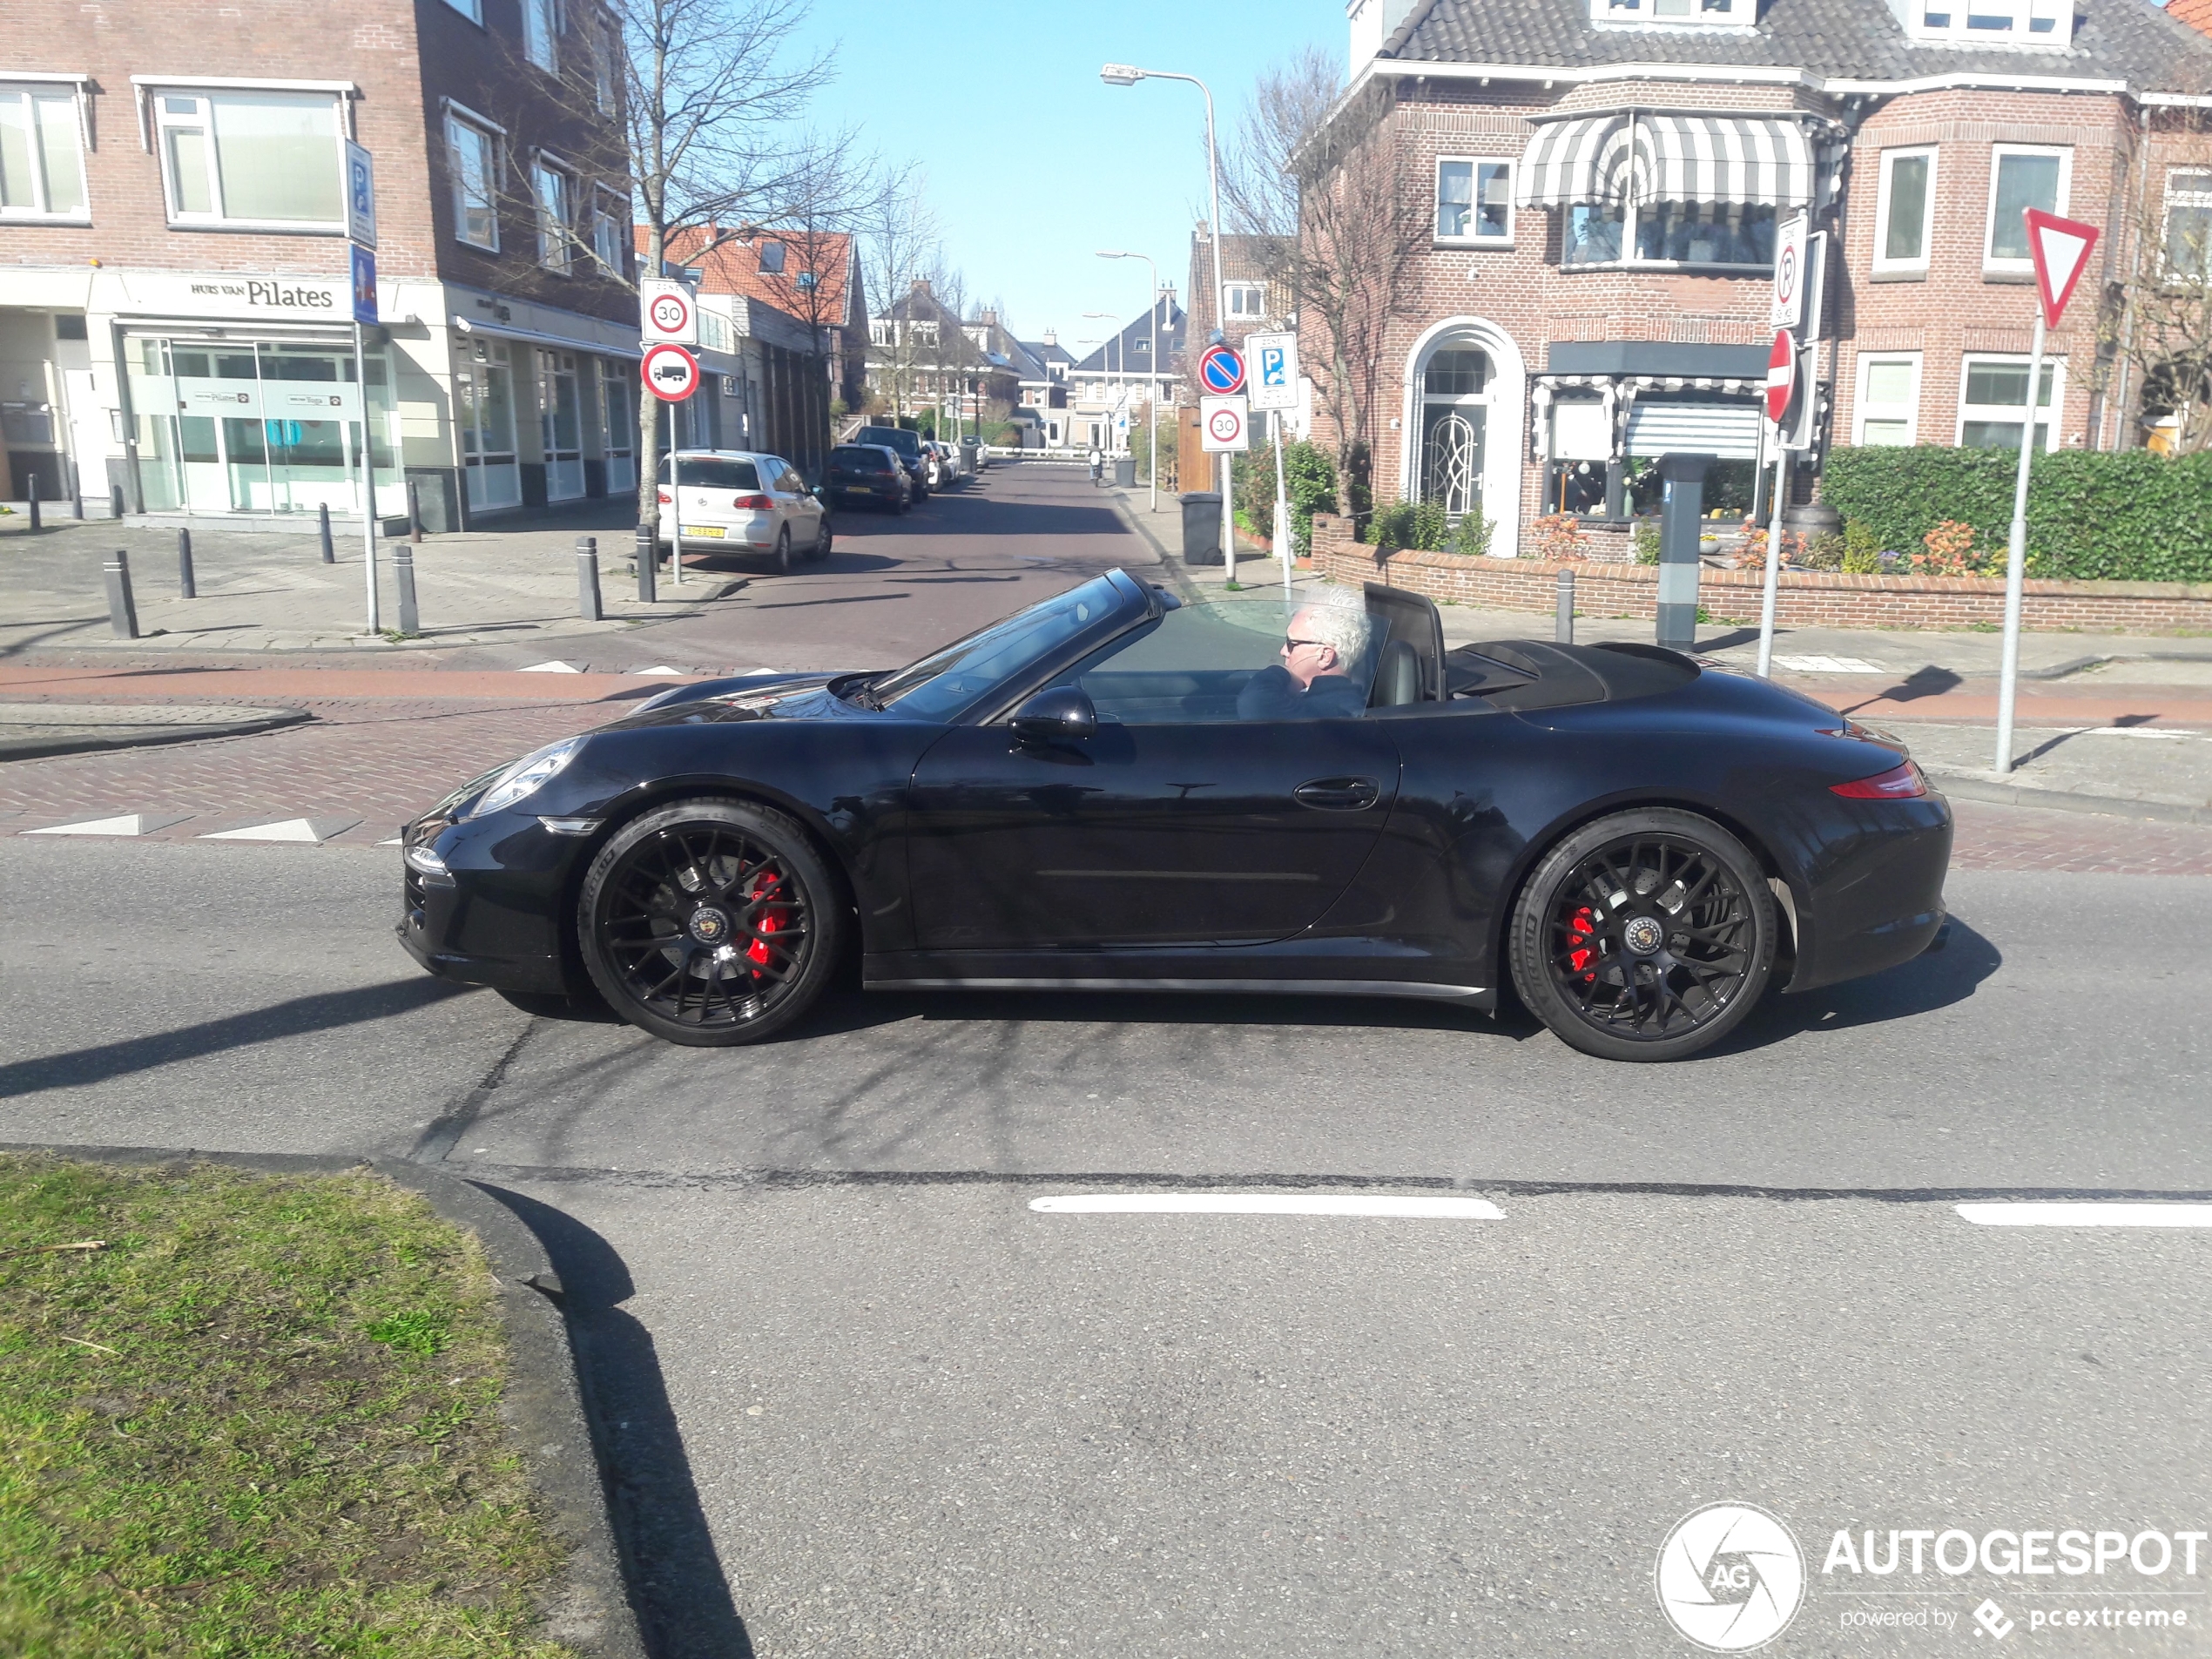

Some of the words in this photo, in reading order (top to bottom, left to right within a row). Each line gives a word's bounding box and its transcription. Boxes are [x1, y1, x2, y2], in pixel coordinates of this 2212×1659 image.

[191, 284, 219, 294] HUIS
[220, 285, 245, 295] VAN
[246, 280, 334, 307] Pilates
[658, 306, 680, 320] 30
[1216, 420, 1234, 431] 30
